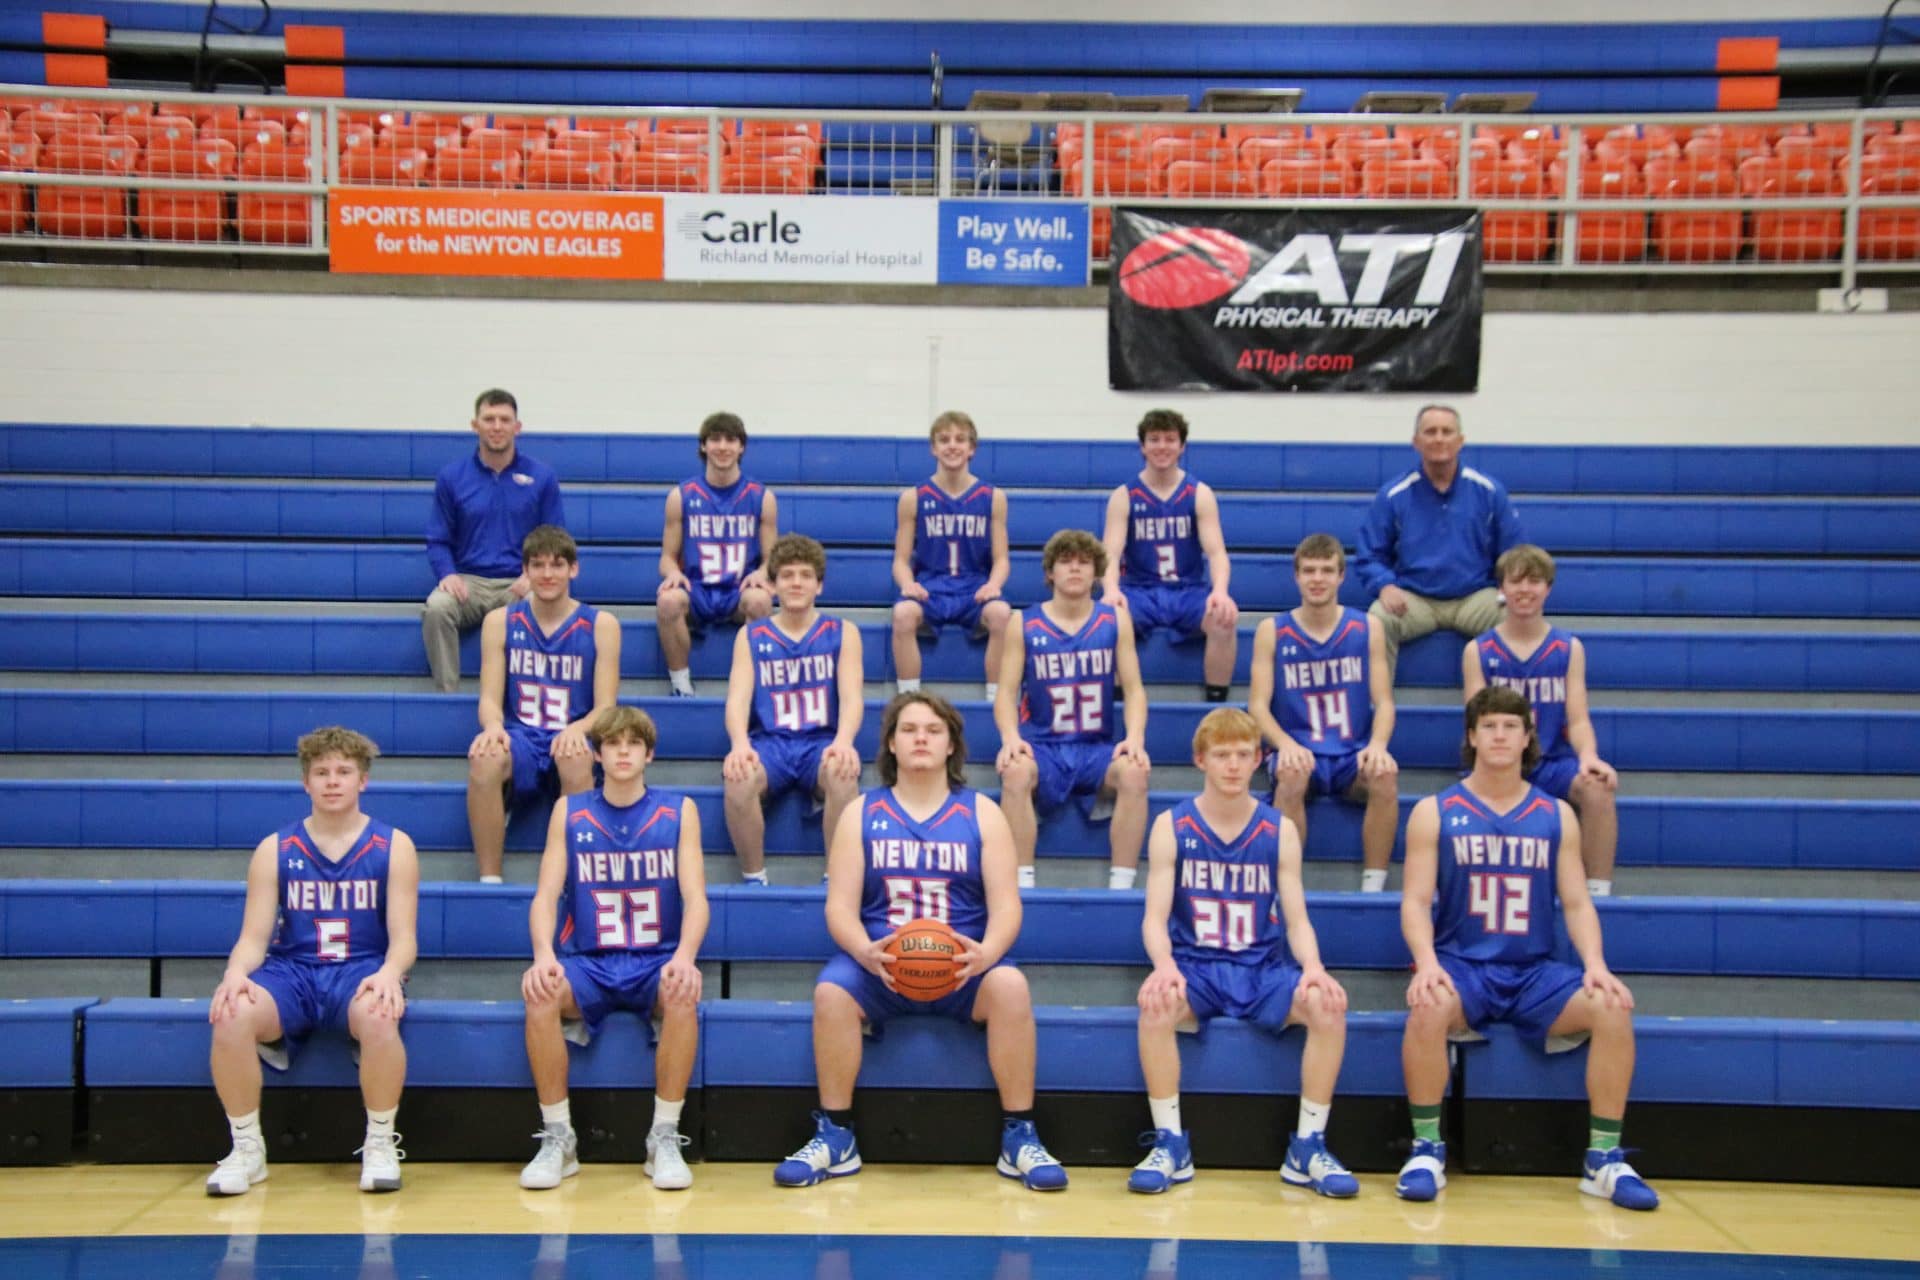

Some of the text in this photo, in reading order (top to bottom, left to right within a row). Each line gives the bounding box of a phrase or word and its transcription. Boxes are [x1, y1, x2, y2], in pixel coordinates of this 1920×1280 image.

[340, 206, 655, 232] SPORTS MEDICINE COVERAGE
[701, 210, 801, 244] Carle
[957, 216, 1074, 245] Play Well.
[375, 233, 622, 257] for the NEWTON EAGLES
[700, 247, 923, 271] Richland Memorial Hospital
[966, 248, 1063, 271] Be Safe.
[1229, 233, 1475, 306] ATI
[1214, 307, 1439, 328] PHYSICAL THERAPY
[1237, 349, 1353, 375] ATIpt.com
[689, 515, 755, 538] NEWTON
[925, 514, 987, 537] NEWTON
[698, 541, 748, 584] 24
[948, 541, 959, 577] 1
[1156, 544, 1179, 581] 2
[509, 647, 583, 681] NEWTON
[759, 653, 834, 687] NEWTON
[1033, 648, 1113, 680] NEWTON
[1283, 656, 1363, 689] NEWTON
[517, 681, 571, 731] 33
[771, 685, 828, 731] 44
[1048, 681, 1103, 734] 22
[1304, 688, 1353, 742] 14
[576, 848, 675, 882] NEWTON
[871, 839, 968, 873] NEWTON
[1452, 835, 1550, 870] NEWTON
[1181, 858, 1272, 894] NEWTON
[592, 887, 661, 948] 32
[884, 875, 951, 928] 50
[1469, 872, 1532, 935] 42
[313, 918, 351, 961] 5
[1190, 896, 1256, 952] 20
[901, 937, 954, 955] Wilson
